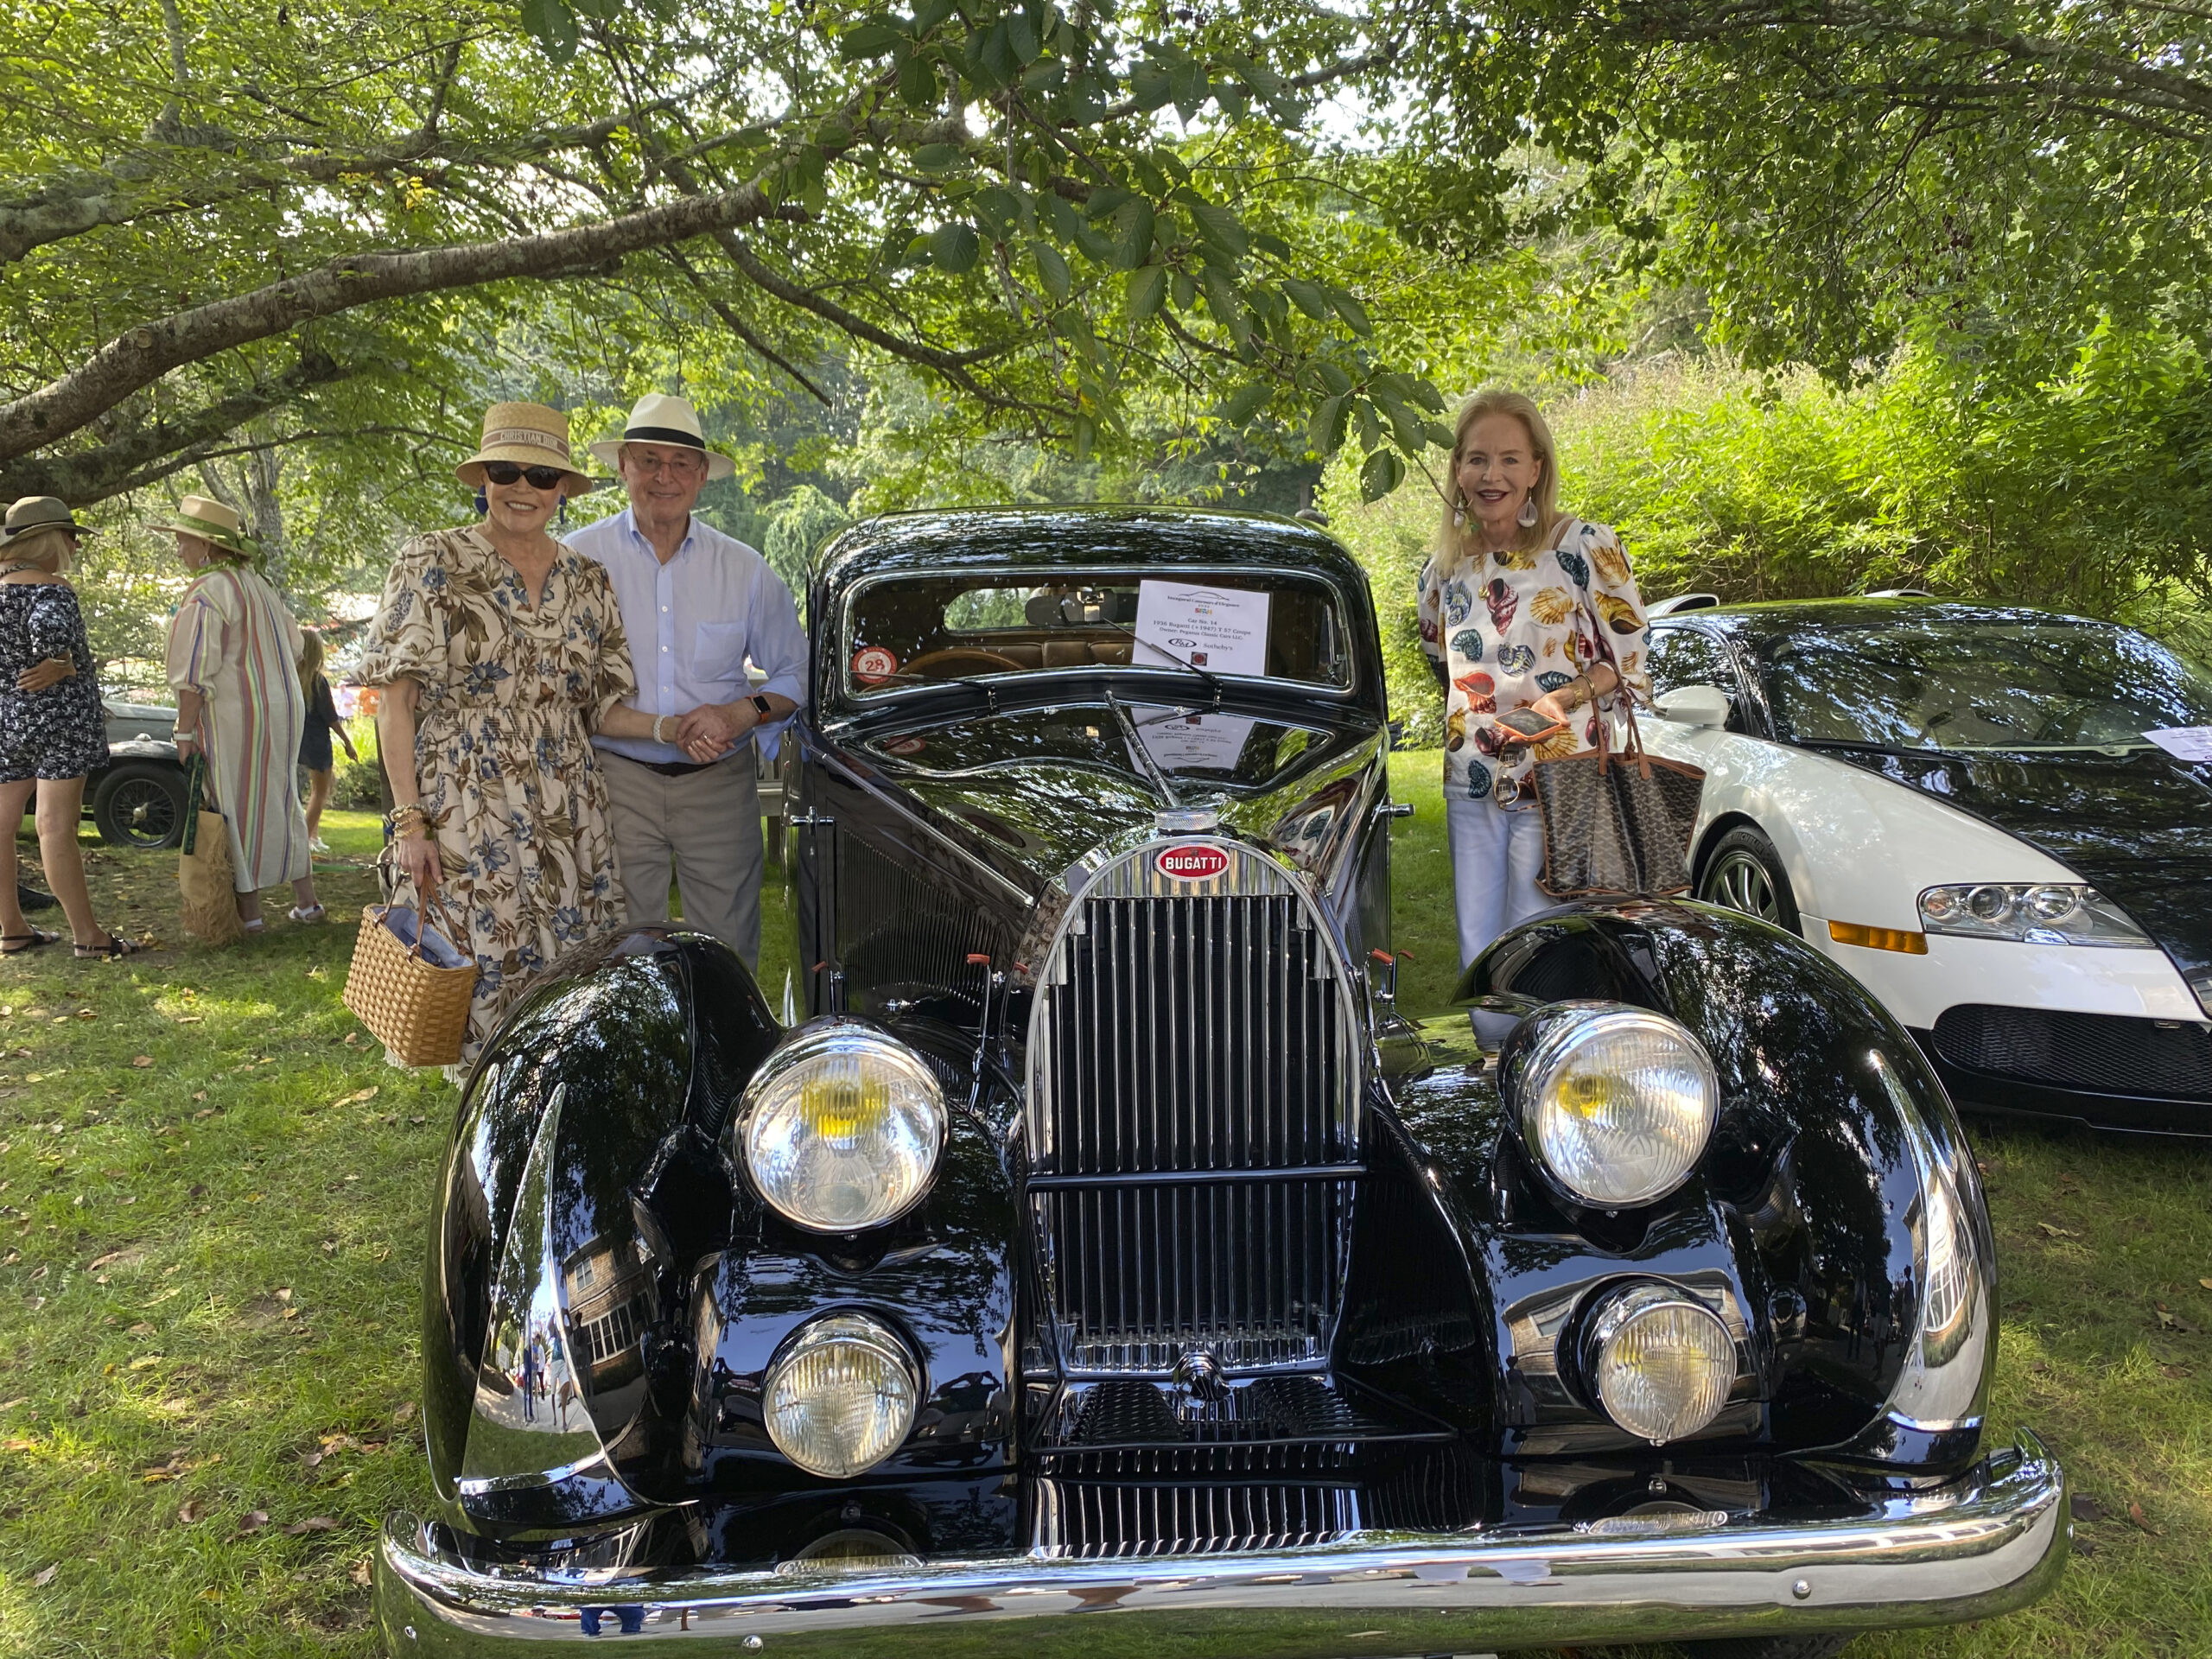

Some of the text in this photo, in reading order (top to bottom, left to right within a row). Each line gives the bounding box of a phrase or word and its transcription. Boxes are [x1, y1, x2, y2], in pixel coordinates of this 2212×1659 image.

[500, 430, 558, 449] CHRISTIAN DIOR
[1169, 621, 1190, 630] Bugatti
[865, 658, 885, 671] 28
[1166, 856, 1222, 870] BUGATTI
